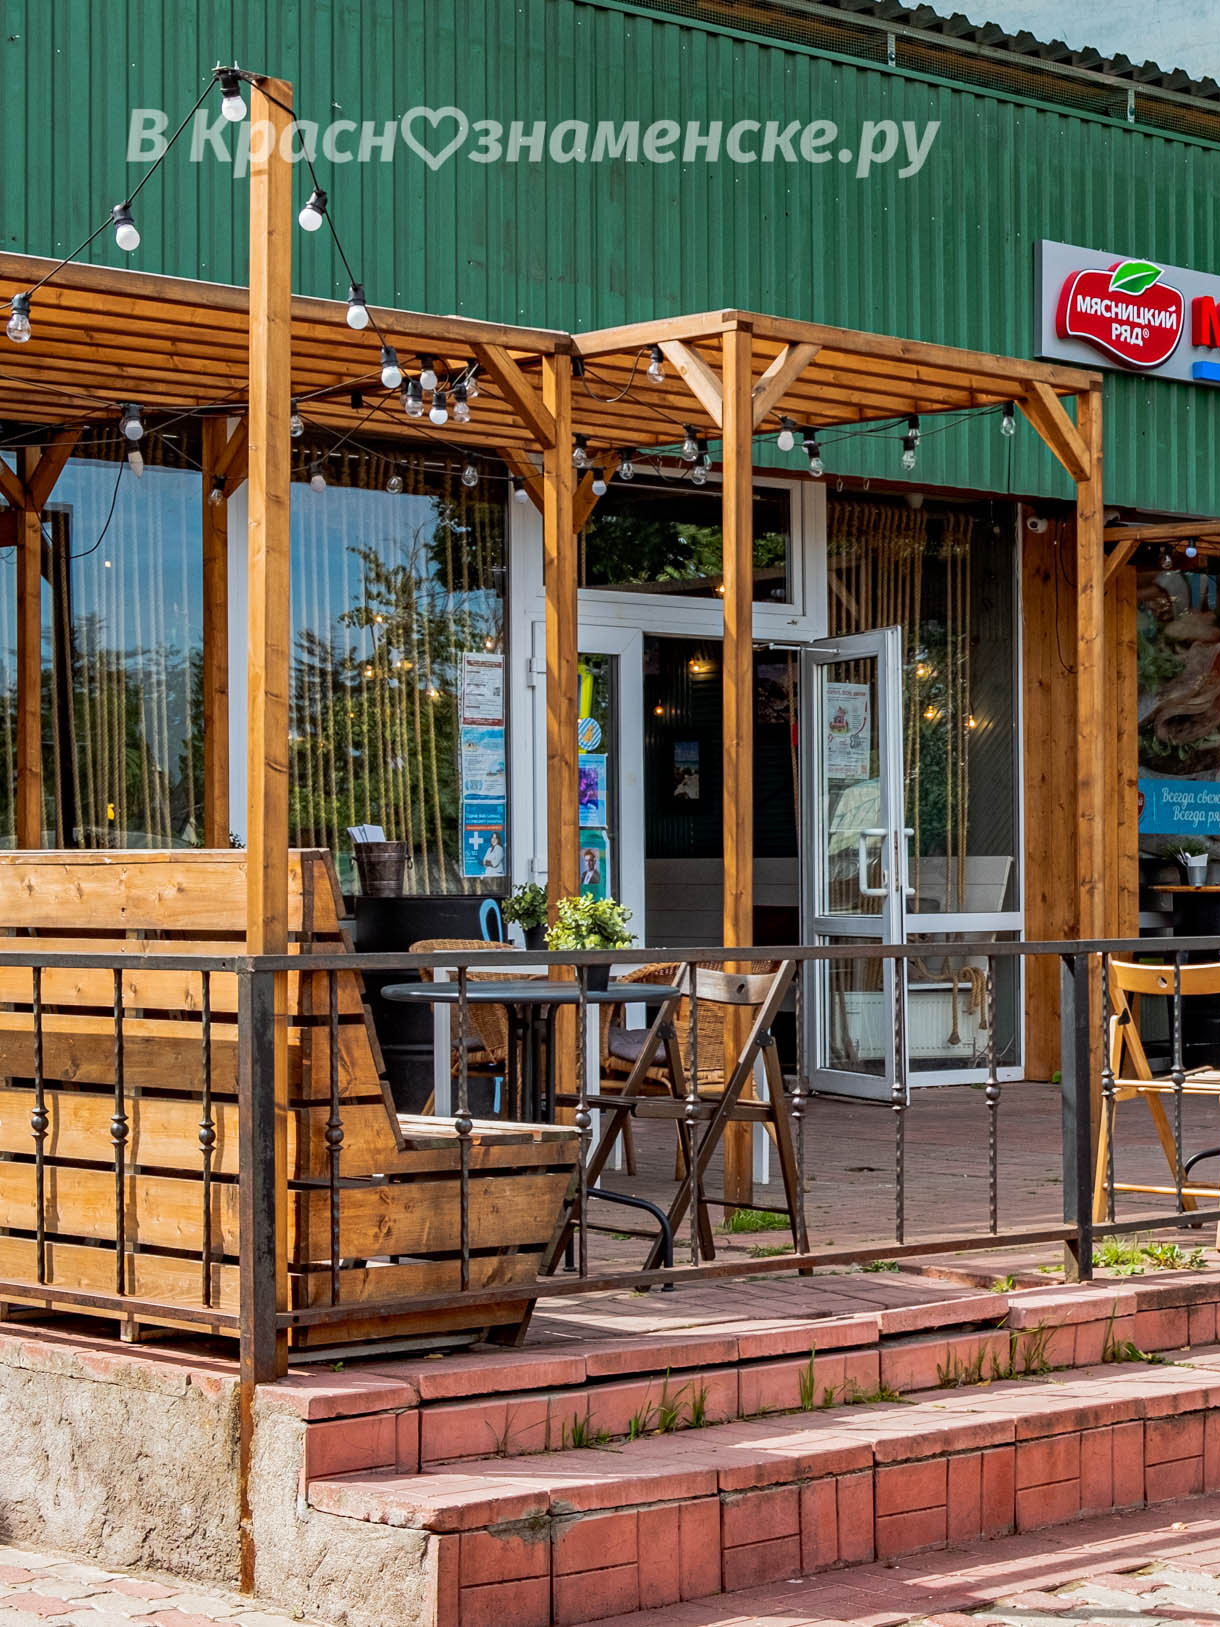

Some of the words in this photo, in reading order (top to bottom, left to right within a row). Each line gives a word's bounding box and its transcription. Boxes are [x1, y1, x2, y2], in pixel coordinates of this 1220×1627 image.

[1076, 294, 1177, 330] МЯСНИЦКИЙ
[1161, 787, 1195, 809] Всегда
[1172, 805, 1206, 828] Всегда
